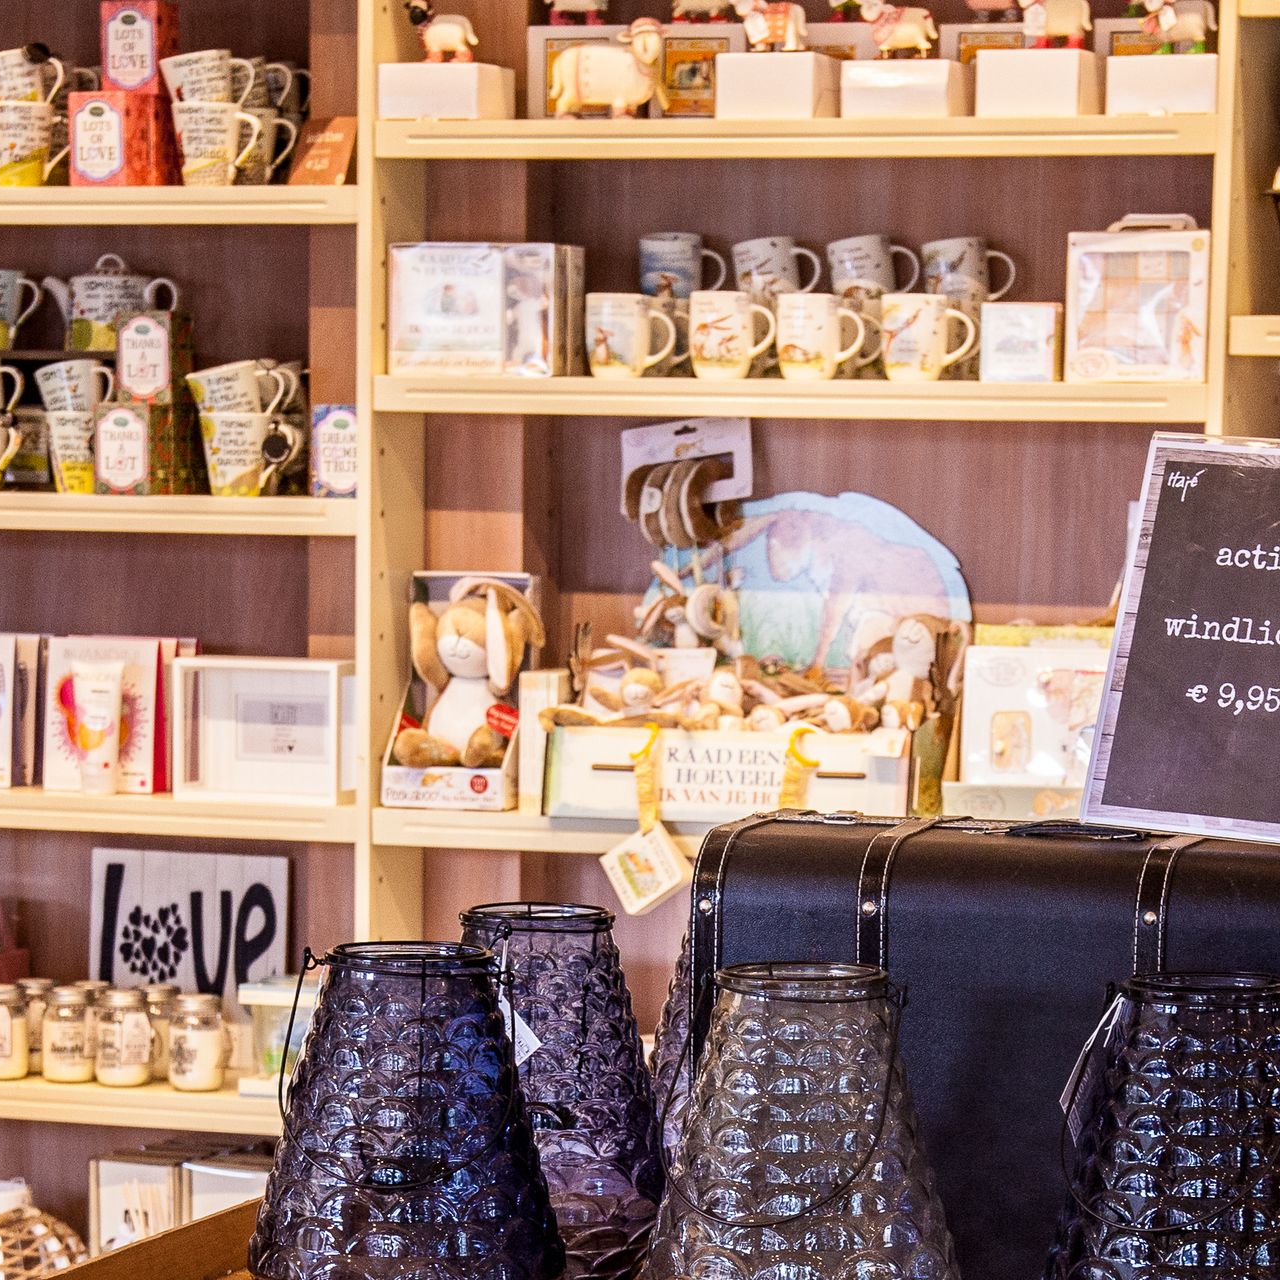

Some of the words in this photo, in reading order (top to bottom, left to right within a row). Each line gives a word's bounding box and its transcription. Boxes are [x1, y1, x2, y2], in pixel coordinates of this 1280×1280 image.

[115, 28, 145, 41] LOTS
[111, 54, 148, 70] LOVE
[82, 121, 112, 132] LOTS
[79, 146, 117, 162] LOVE
[125, 338, 162, 349] THANKS
[127, 365, 160, 379] LOT
[103, 430, 140, 442] THANKS
[105, 456, 138, 471] LOT
[1185, 683, 1208, 704] €
[1217, 682, 1280, 717] 9,95
[666, 747, 733, 766] RAAD
[675, 766, 781, 788] HOEVEEL
[659, 787, 677, 802] IK
[679, 787, 720, 805] VAN
[723, 789, 748, 806] JE
[750, 790, 782, 808] HO
